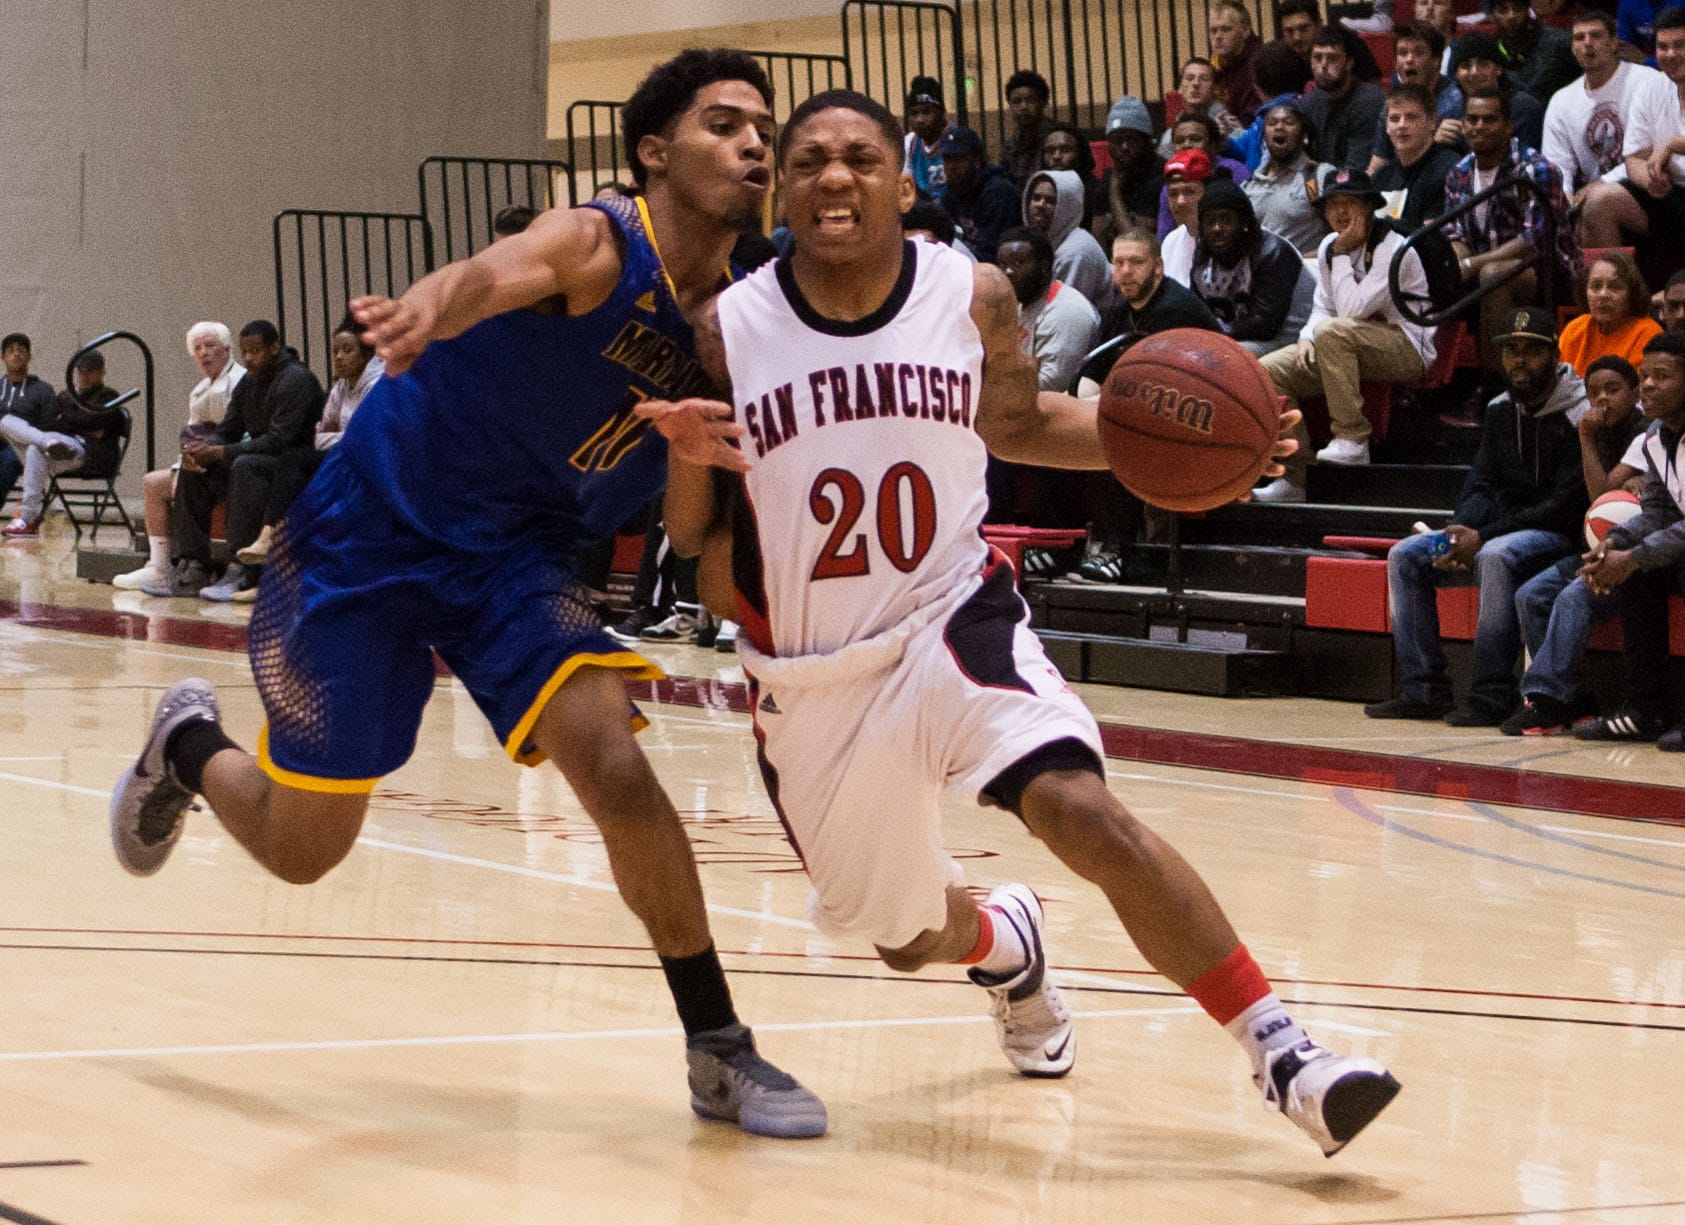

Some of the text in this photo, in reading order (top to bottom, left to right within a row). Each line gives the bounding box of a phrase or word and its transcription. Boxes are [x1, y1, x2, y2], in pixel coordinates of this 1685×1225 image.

[745, 362, 972, 459] SAN FRANCISCO
[1110, 376, 1215, 435] Wilson
[809, 460, 937, 582] 20
